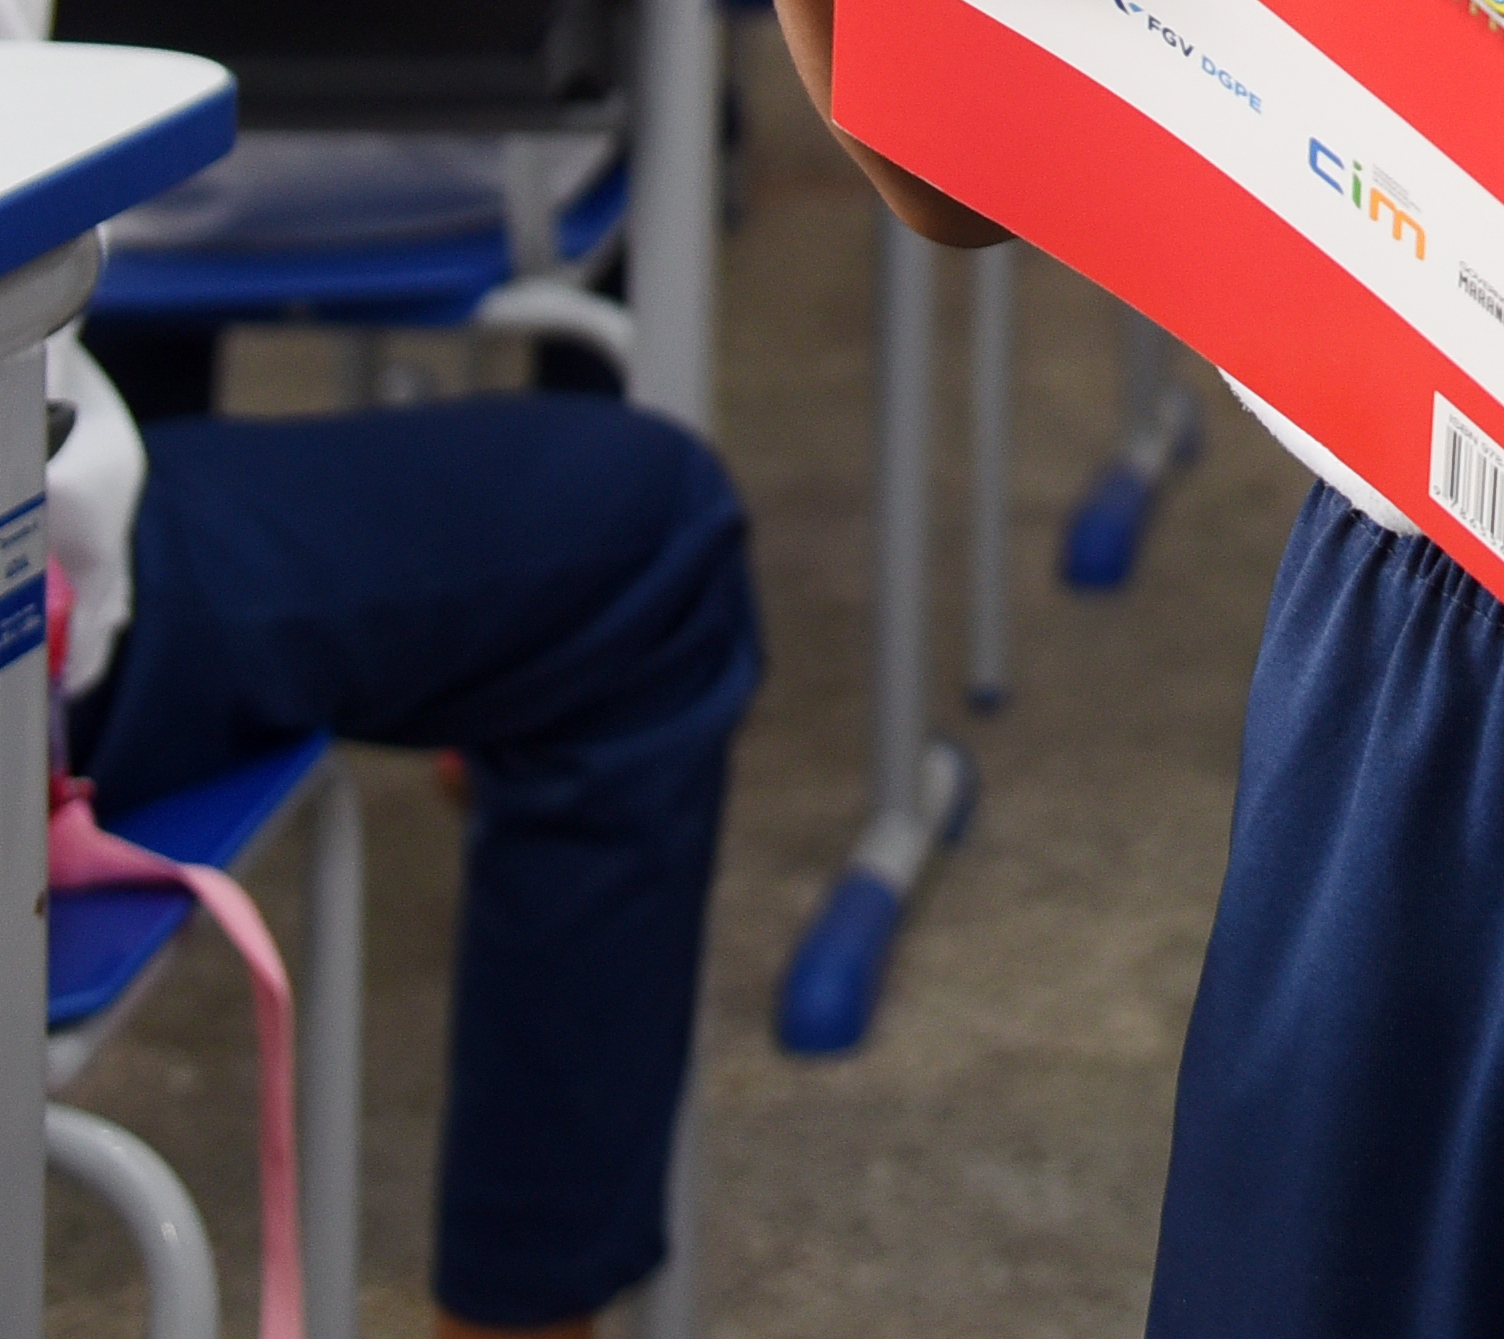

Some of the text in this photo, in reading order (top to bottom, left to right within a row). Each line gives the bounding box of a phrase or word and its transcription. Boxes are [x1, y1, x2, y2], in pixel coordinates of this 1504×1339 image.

[1147, 14, 1263, 115] FGV DGPE
[1308, 136, 1426, 261] cim
